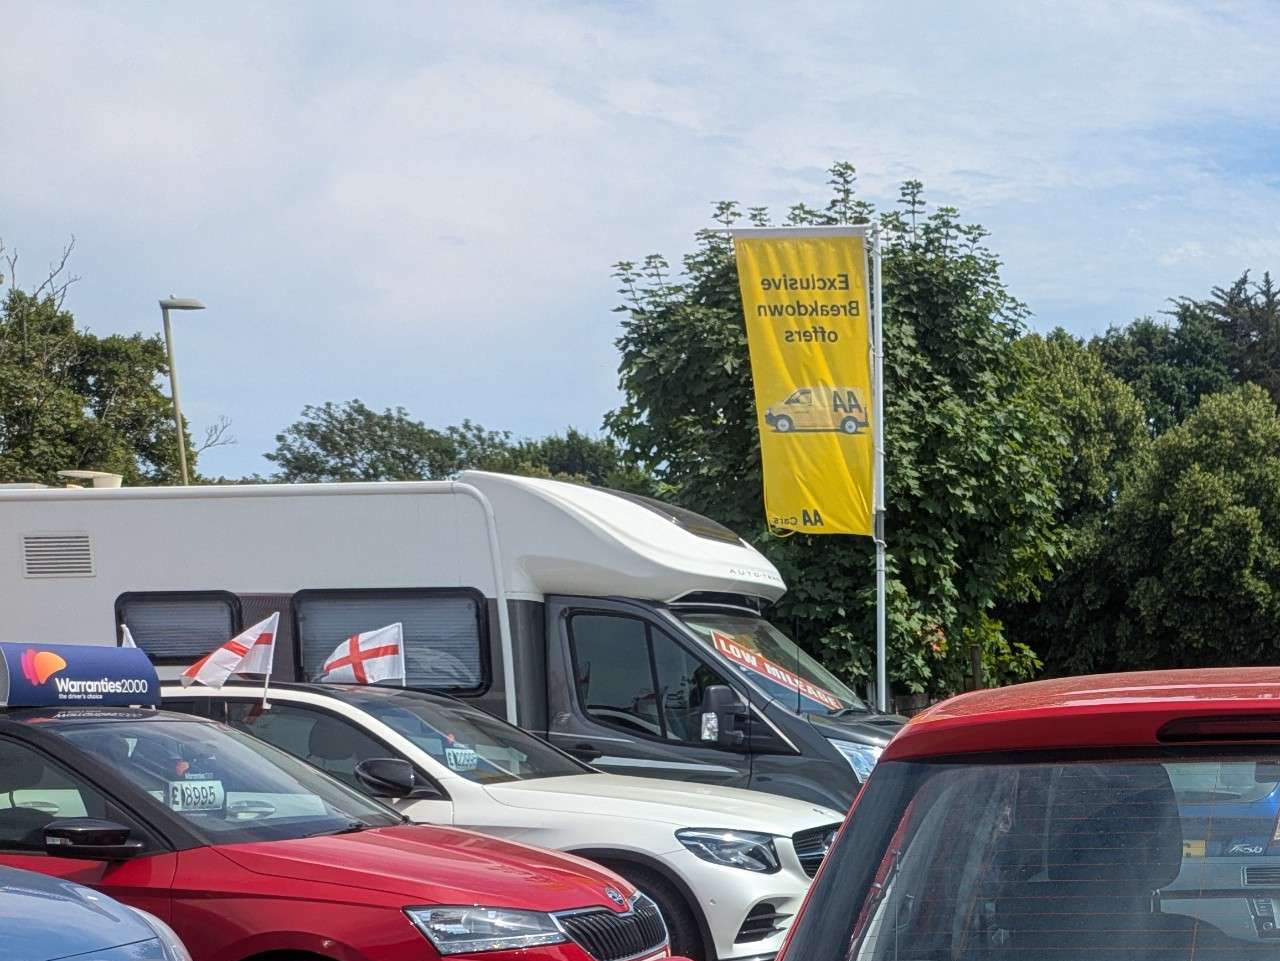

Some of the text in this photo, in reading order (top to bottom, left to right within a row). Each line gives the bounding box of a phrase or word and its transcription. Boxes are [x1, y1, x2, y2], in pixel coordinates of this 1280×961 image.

[54, 677, 148, 693] Warranties2000
[719, 638, 838, 709] LOW MILEAGE
